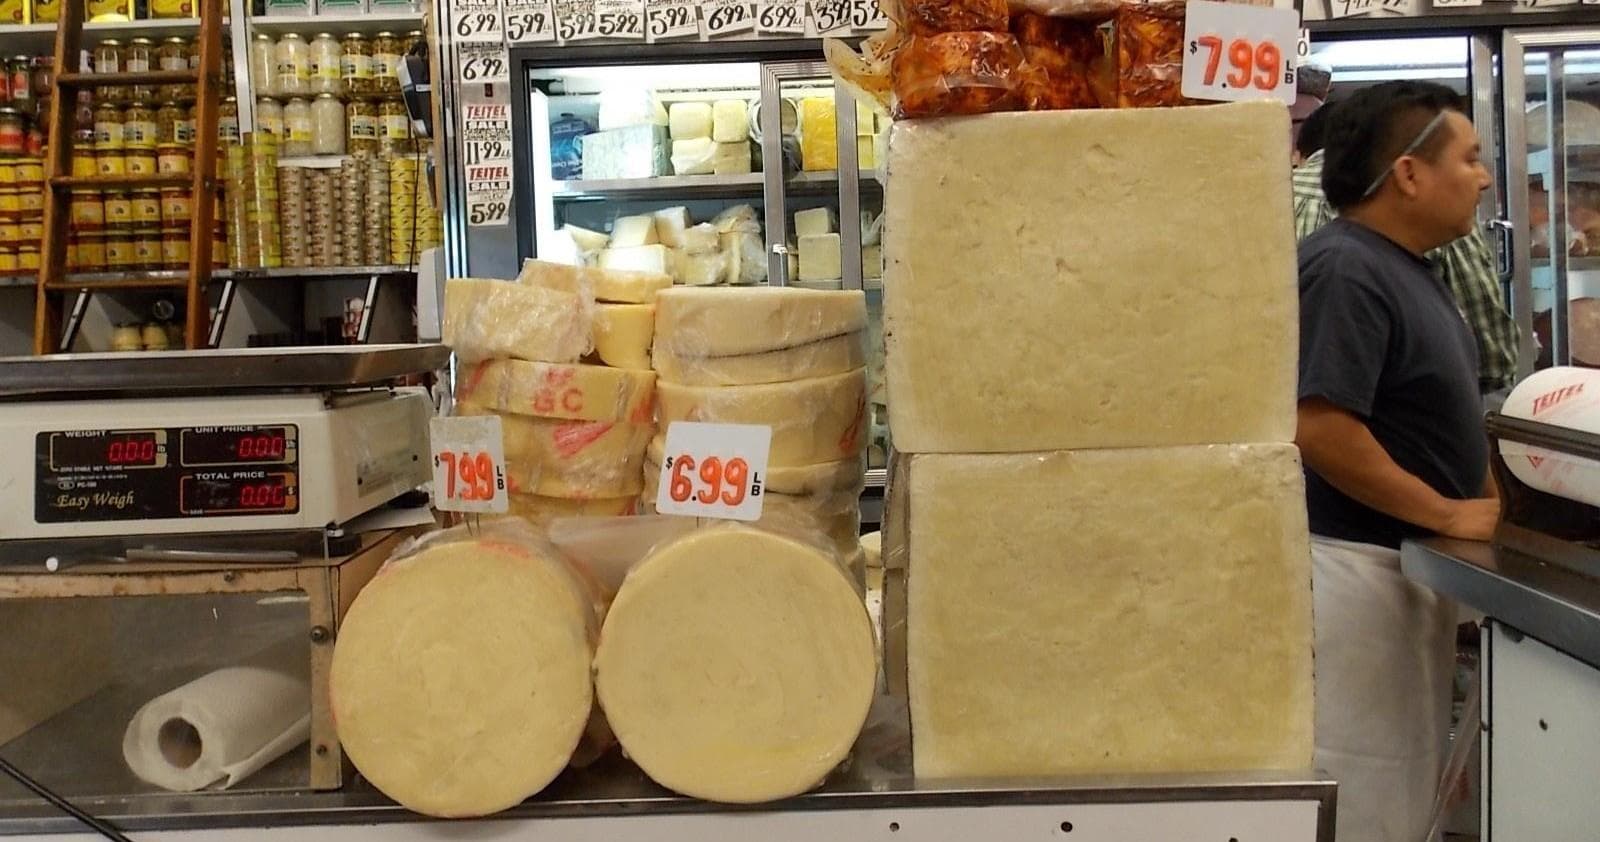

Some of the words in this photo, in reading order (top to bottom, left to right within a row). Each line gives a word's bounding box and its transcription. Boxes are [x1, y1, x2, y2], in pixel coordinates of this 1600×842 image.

[457, 13, 496, 36] 6.99
[508, 13, 545, 40] 5.99
[599, 14, 638, 35] 5.99
[650, 7, 688, 35] 5.99
[760, 5, 796, 27] 6.99
[463, 58, 502, 80] 6.99
[467, 106, 507, 119] TEITEL
[470, 167, 509, 180] TEITEL
[470, 202, 506, 224] 5.99
[1532, 384, 1584, 416] TEITEL
[233, 471, 265, 479] PRICE
[56, 494, 90, 509] Easy
[93, 490, 134, 509] Weigh
